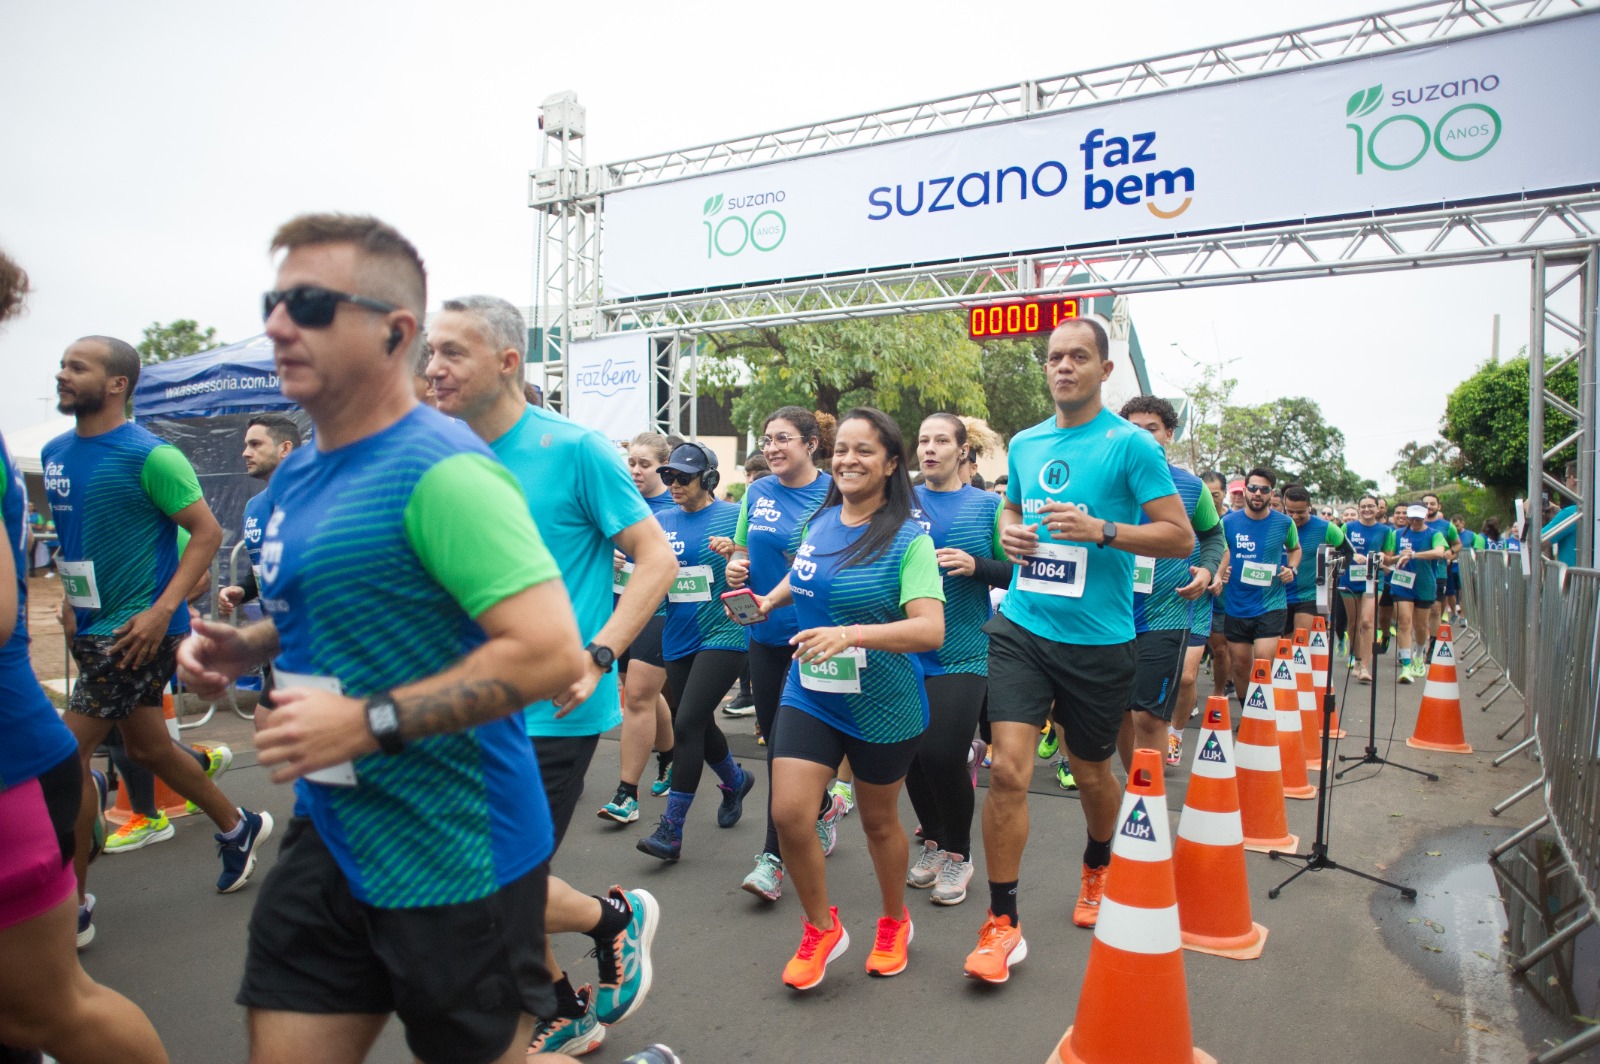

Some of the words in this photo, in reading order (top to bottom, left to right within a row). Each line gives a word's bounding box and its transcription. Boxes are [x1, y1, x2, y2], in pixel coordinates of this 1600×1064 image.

[1391, 74, 1500, 107] suzano
[1346, 103, 1502, 175] 100
[1446, 124, 1489, 141] ANOS
[1080, 128, 1157, 170] faz
[867, 160, 1068, 221] suzano
[1084, 167, 1195, 210] bem
[728, 190, 786, 210] suzano
[703, 209, 786, 259] 100
[757, 225, 780, 236] ANOS
[166, 373, 281, 399] wxassessoria.com.br
[45, 461, 64, 476] faz
[1047, 467, 1062, 485] H
[45, 477, 71, 490] bem
[755, 496, 776, 509] faz
[754, 506, 781, 519] bem
[245, 516, 258, 528] faz
[753, 524, 777, 533] suzano
[1236, 532, 1249, 541] faz
[1237, 541, 1256, 549] bem
[1031, 561, 1066, 579] 1064
[1250, 570, 1265, 579] 429
[677, 580, 697, 591] 443
[1249, 698, 1264, 708] WX
[1202, 750, 1222, 761] WX
[1125, 821, 1150, 838] WX
